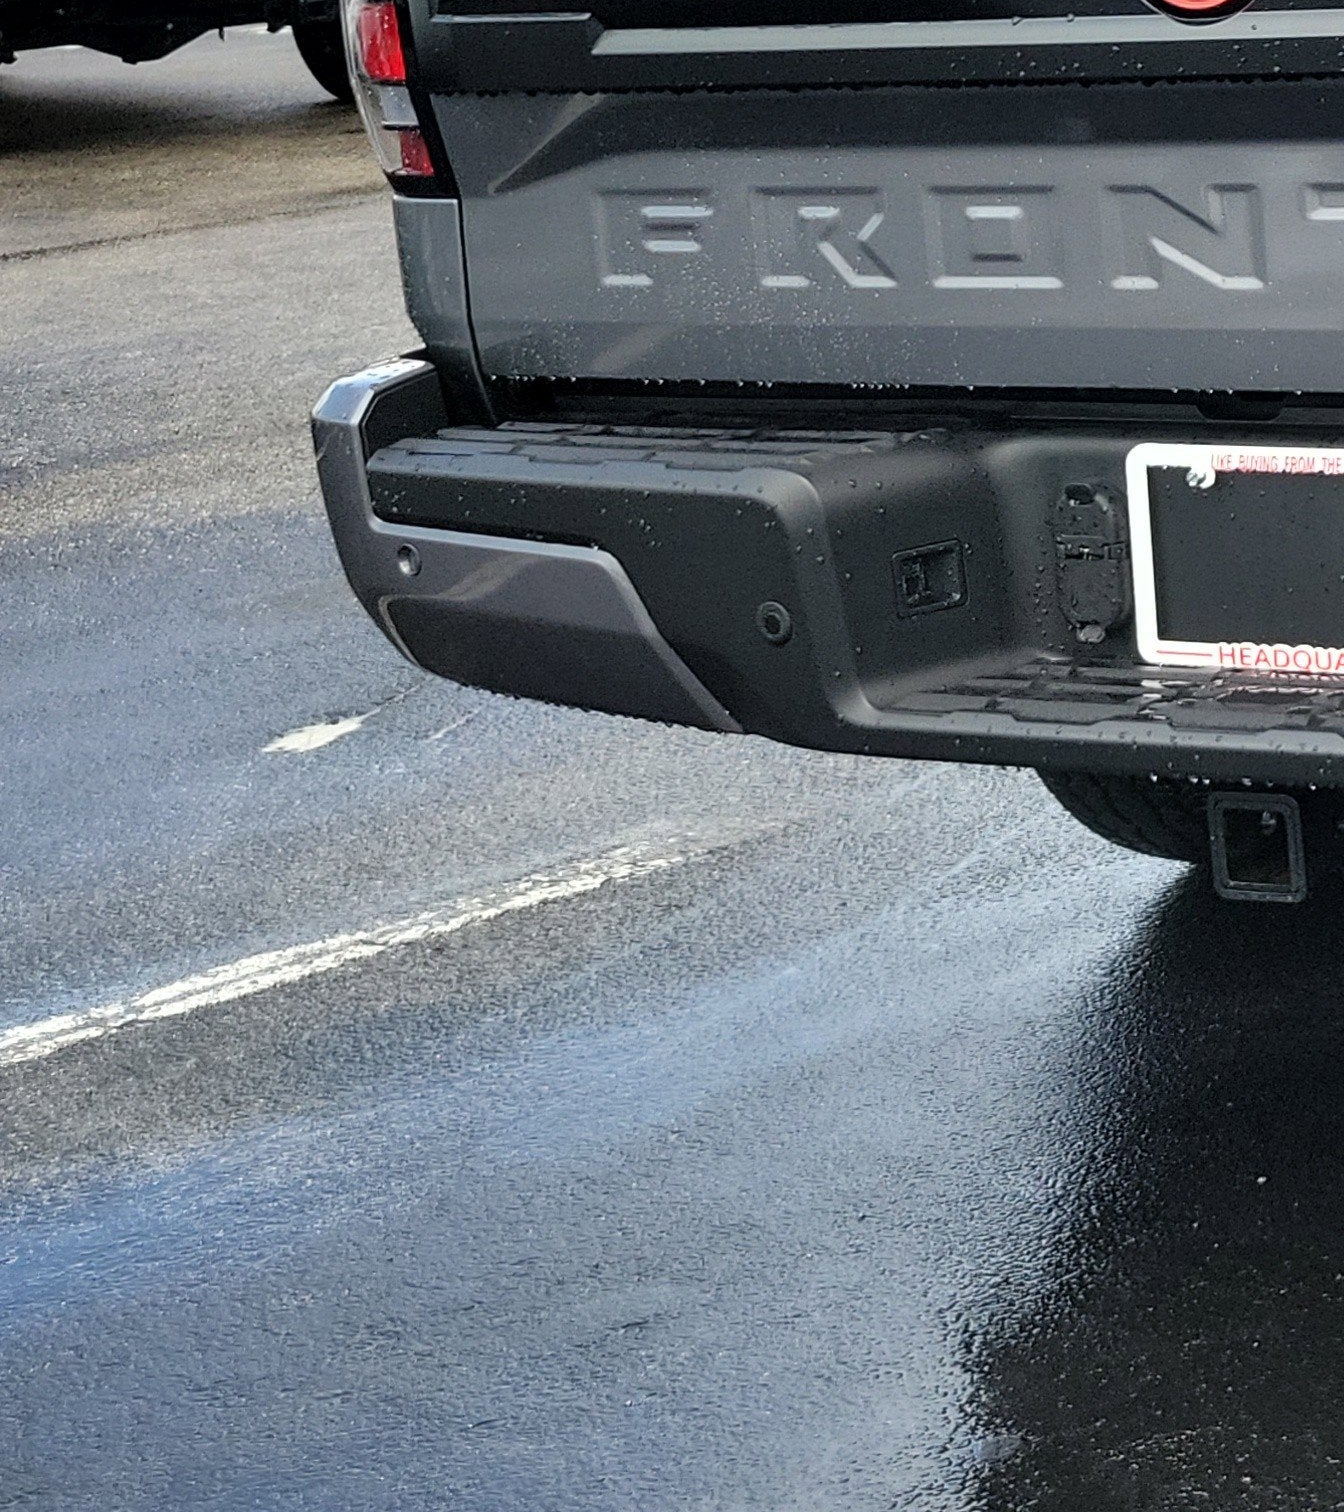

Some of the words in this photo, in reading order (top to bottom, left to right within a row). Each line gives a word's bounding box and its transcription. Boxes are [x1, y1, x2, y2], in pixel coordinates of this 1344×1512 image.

[1211, 453, 1232, 471] LIKE
[1239, 454, 1278, 473] BUYING
[1285, 455, 1315, 474] FROM
[1321, 457, 1342, 475] THE
